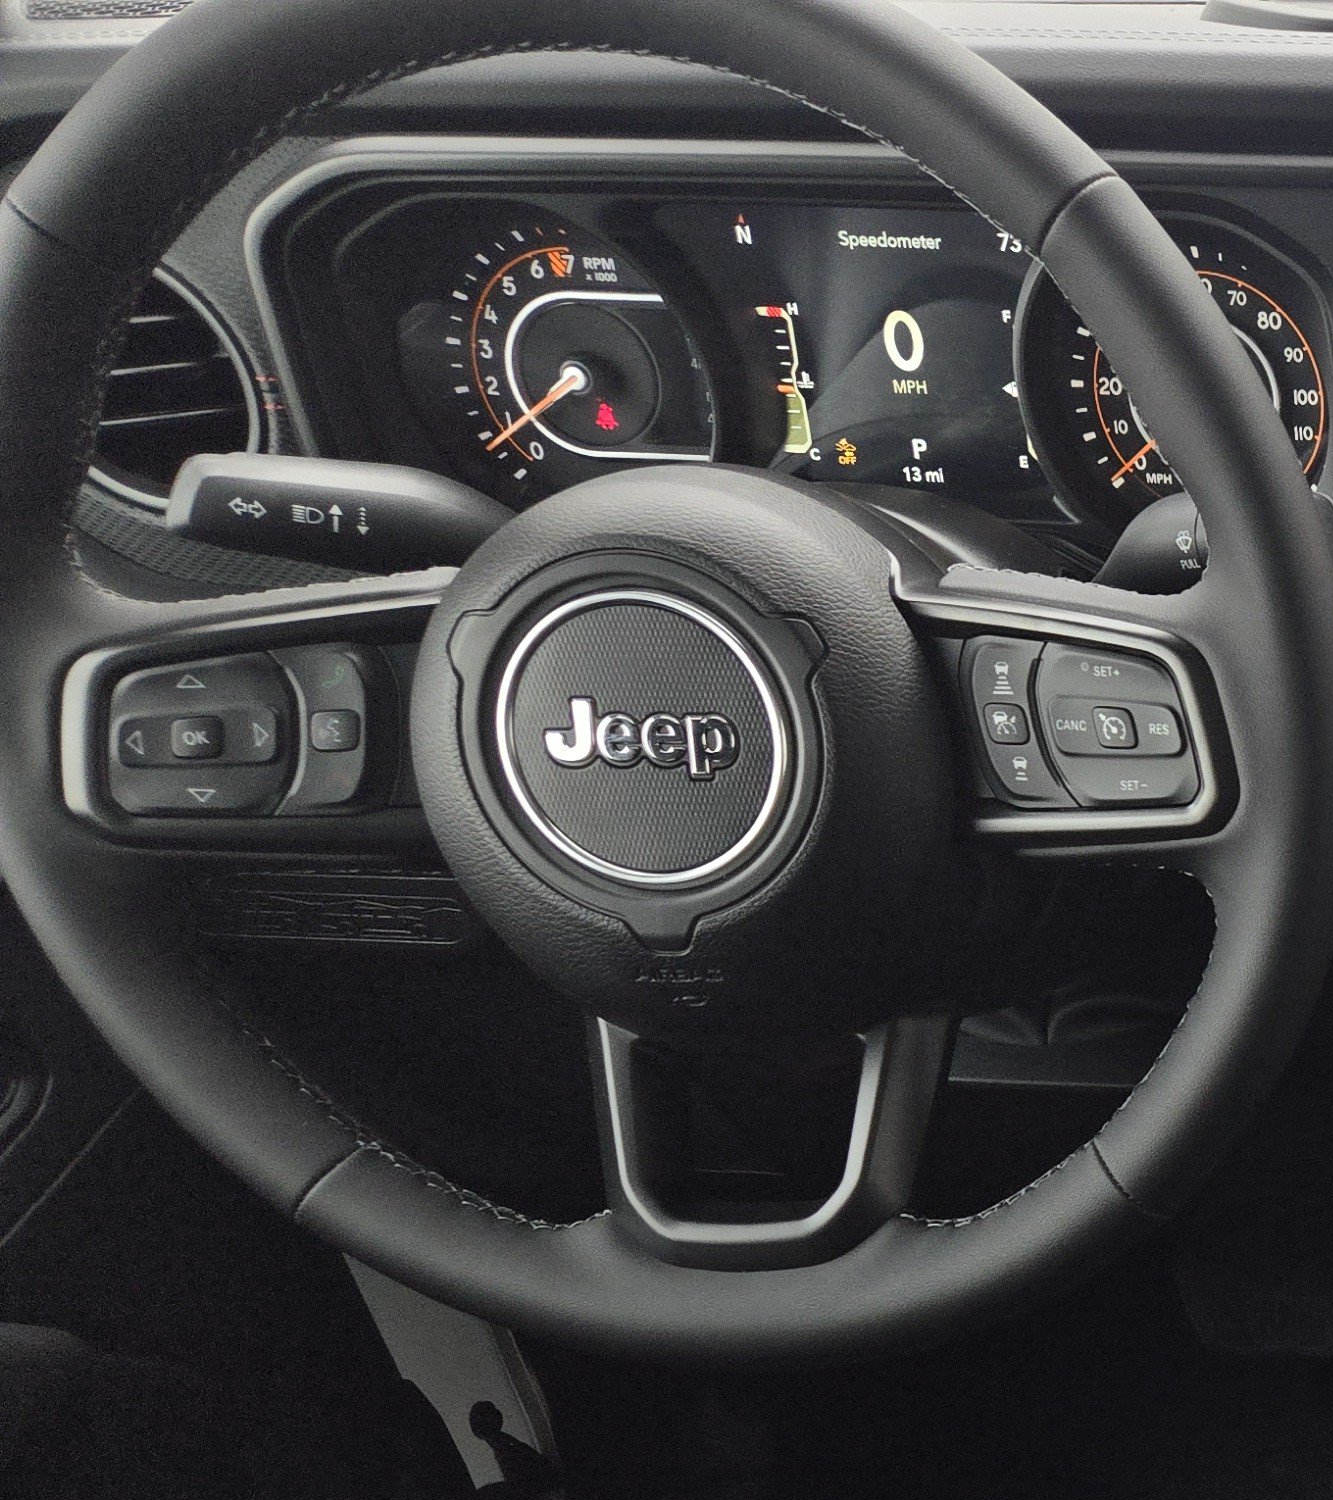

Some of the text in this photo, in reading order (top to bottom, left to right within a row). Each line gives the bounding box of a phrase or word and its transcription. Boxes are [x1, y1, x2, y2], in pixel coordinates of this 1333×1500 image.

[735, 225, 752, 245] N
[837, 230, 942, 251] Speedometer
[530, 259, 545, 280] 6
[561, 255, 575, 274] 7
[582, 257, 616, 272] RPM
[502, 276, 517, 296] 5
[595, 273, 618, 283] 1000
[1227, 290, 1248, 307] 70
[484, 304, 499, 325] 4
[786, 302, 799, 316] H
[1001, 309, 1012, 324] F
[1256, 310, 1282, 331] 80
[479, 339, 493, 360] 3
[883, 310, 925, 372] 0
[1284, 347, 1304, 363] 90
[484, 376, 500, 397] 2
[892, 379, 928, 396] MPH
[1098, 376, 1123, 396] 20
[1293, 388, 1319, 406] 100
[1113, 419, 1129, 435] 10
[1293, 425, 1314, 441] 110
[529, 441, 544, 461] 0
[810, 447, 821, 461] C
[911, 438, 928, 460] P
[1018, 455, 1029, 469] E
[902, 466, 945, 484] 13 mi
[1146, 473, 1173, 485] MPH
[1180, 558, 1200, 571] PULL
[1055, 718, 1087, 732] CANC
[1148, 723, 1170, 736] RES
[181, 729, 210, 747] OK
[543, 696, 741, 781] Jeep
